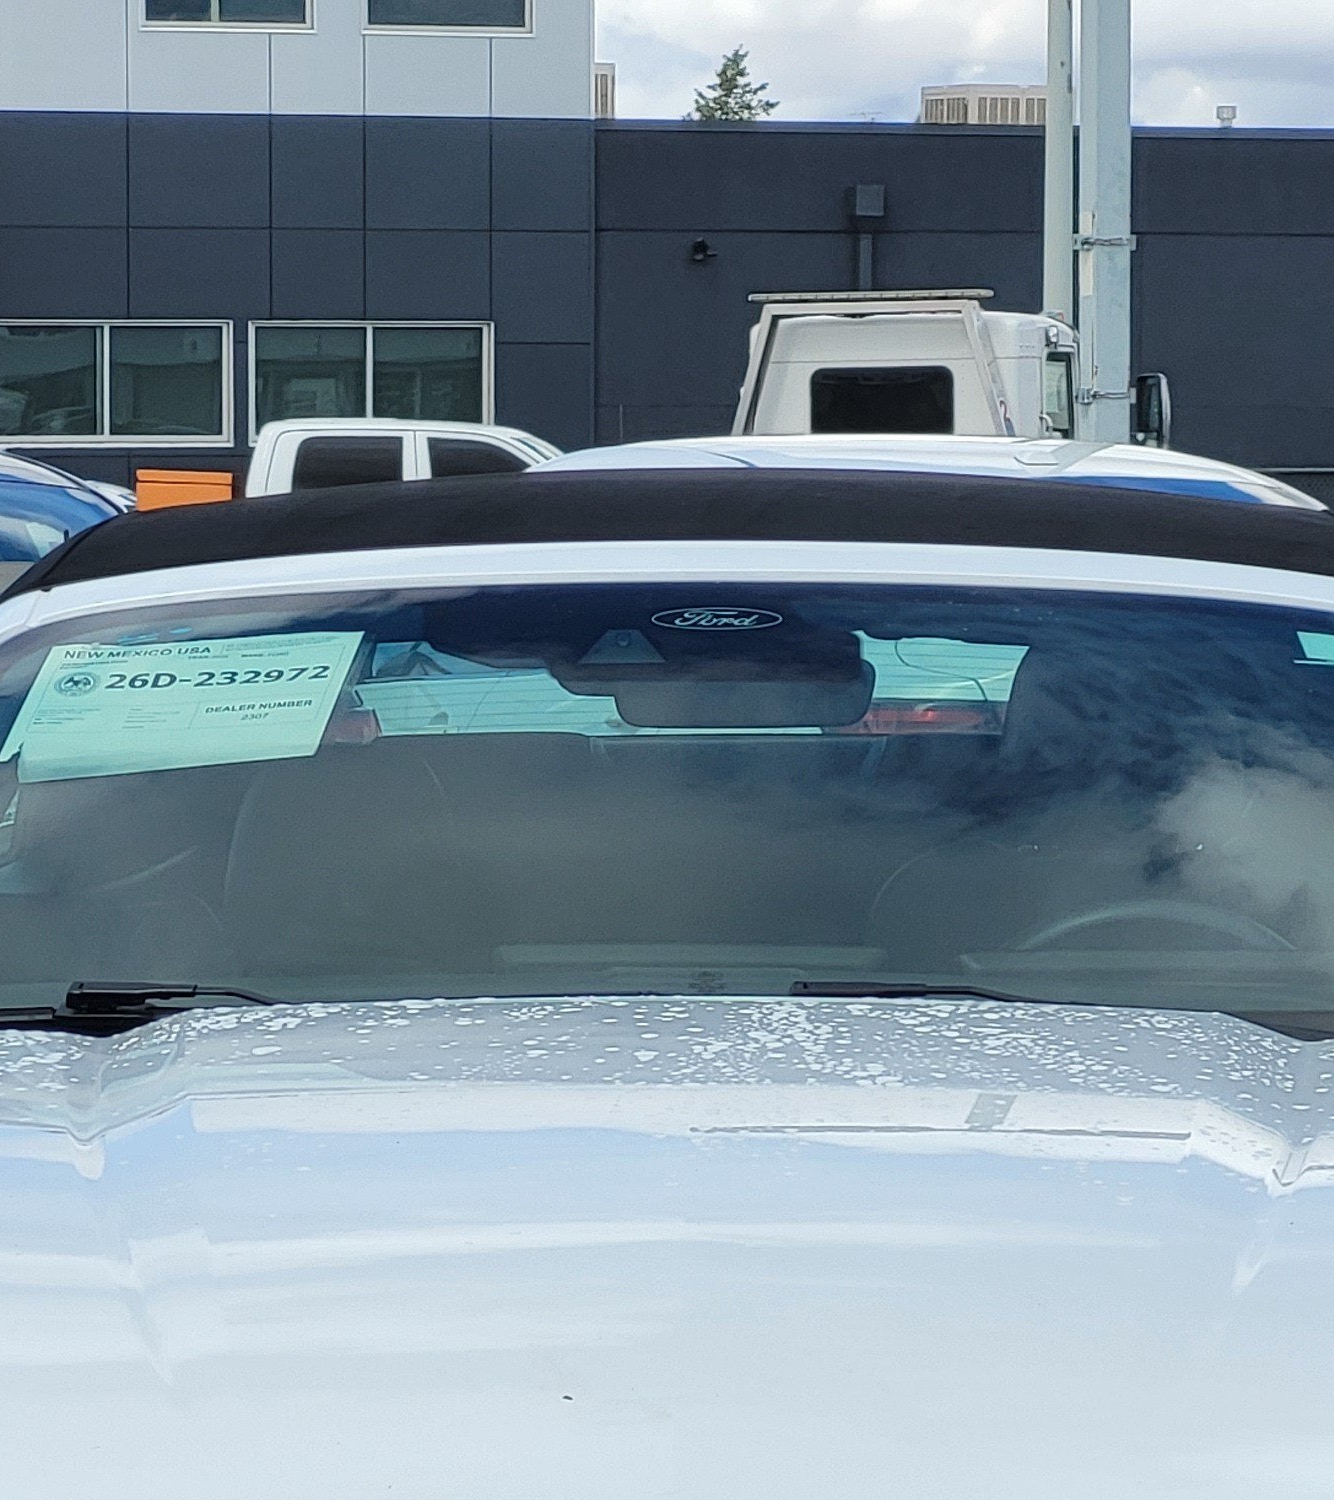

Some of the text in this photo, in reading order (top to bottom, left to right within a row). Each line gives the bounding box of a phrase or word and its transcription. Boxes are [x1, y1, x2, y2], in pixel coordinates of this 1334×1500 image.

[674, 610, 759, 626] Ford
[64, 646, 211, 659] NEW MEXICO USA
[104, 665, 331, 690] 26D-232972
[205, 699, 313, 714] DEALER NUMBER
